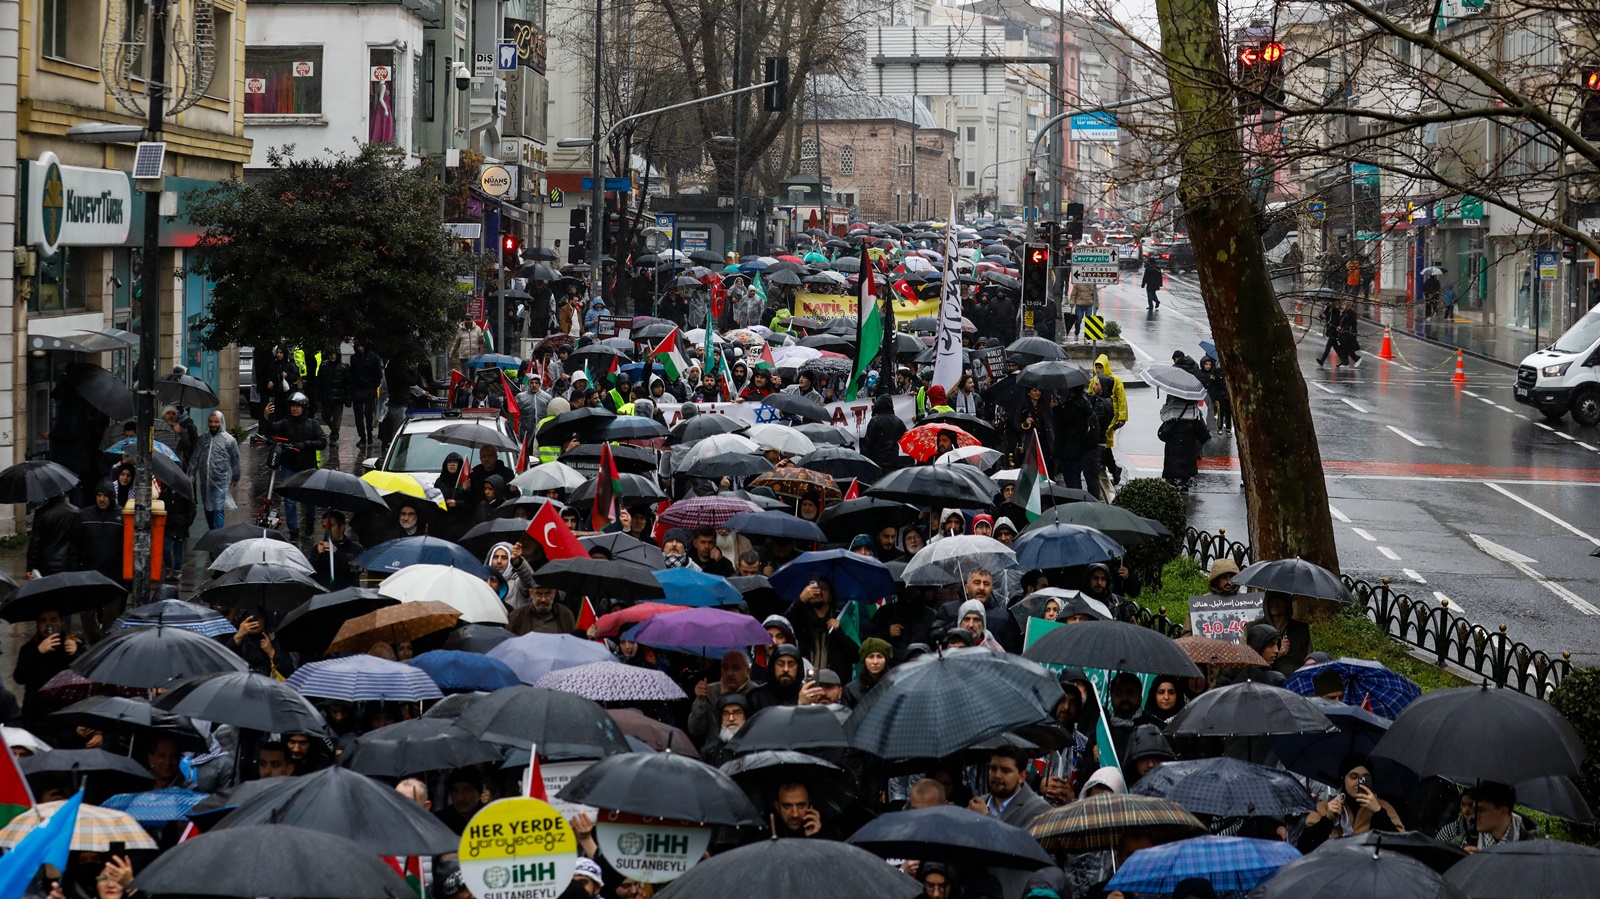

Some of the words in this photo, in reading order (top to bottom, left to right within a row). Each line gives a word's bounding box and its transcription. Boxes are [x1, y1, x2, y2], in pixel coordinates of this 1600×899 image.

[510, 84, 518, 131] DAVET
[484, 175, 508, 185] NÜANS
[1235, 599, 1253, 607] سجون
[1254, 598, 1263, 607] في
[470, 823, 503, 839] HER
[509, 816, 564, 835] YERDE
